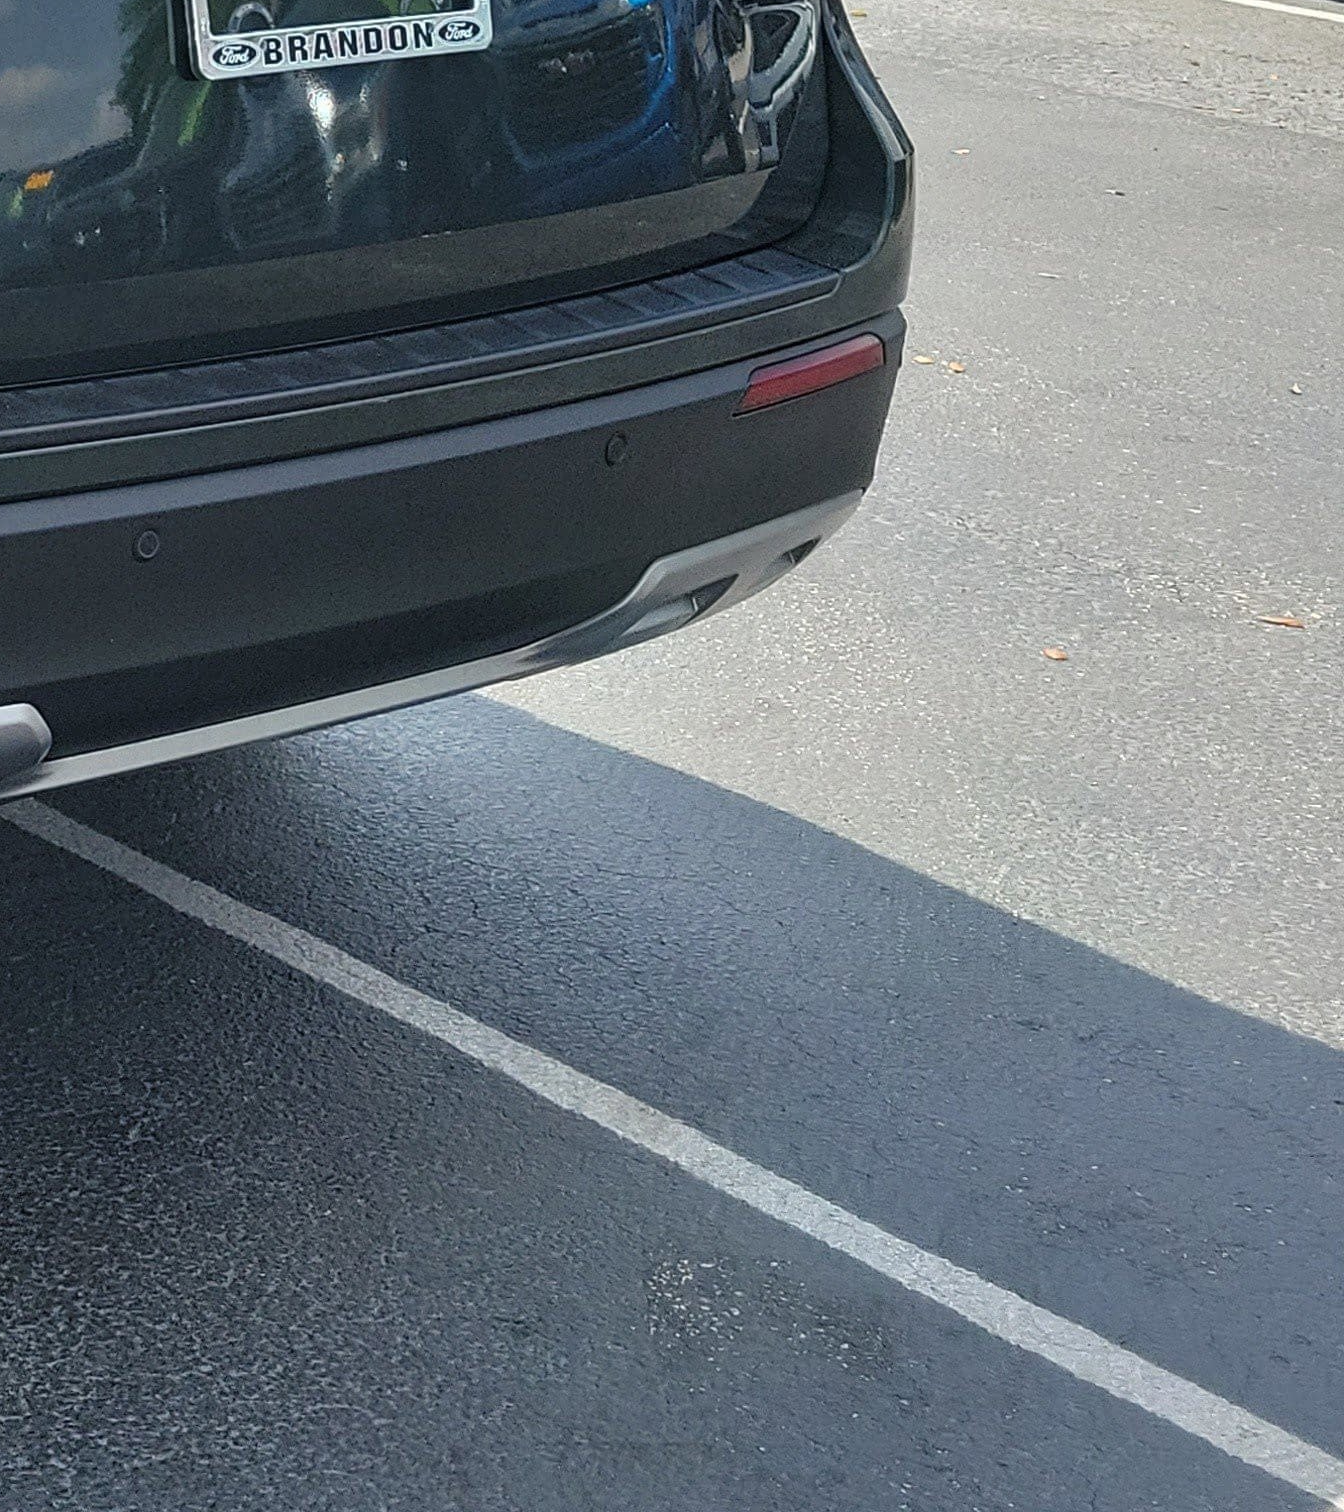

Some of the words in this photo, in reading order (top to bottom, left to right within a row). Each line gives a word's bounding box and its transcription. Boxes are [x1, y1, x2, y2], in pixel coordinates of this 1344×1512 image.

[218, 45, 250, 65] Ford
[263, 20, 434, 66] BRANDON
[445, 22, 476, 41] Ford
